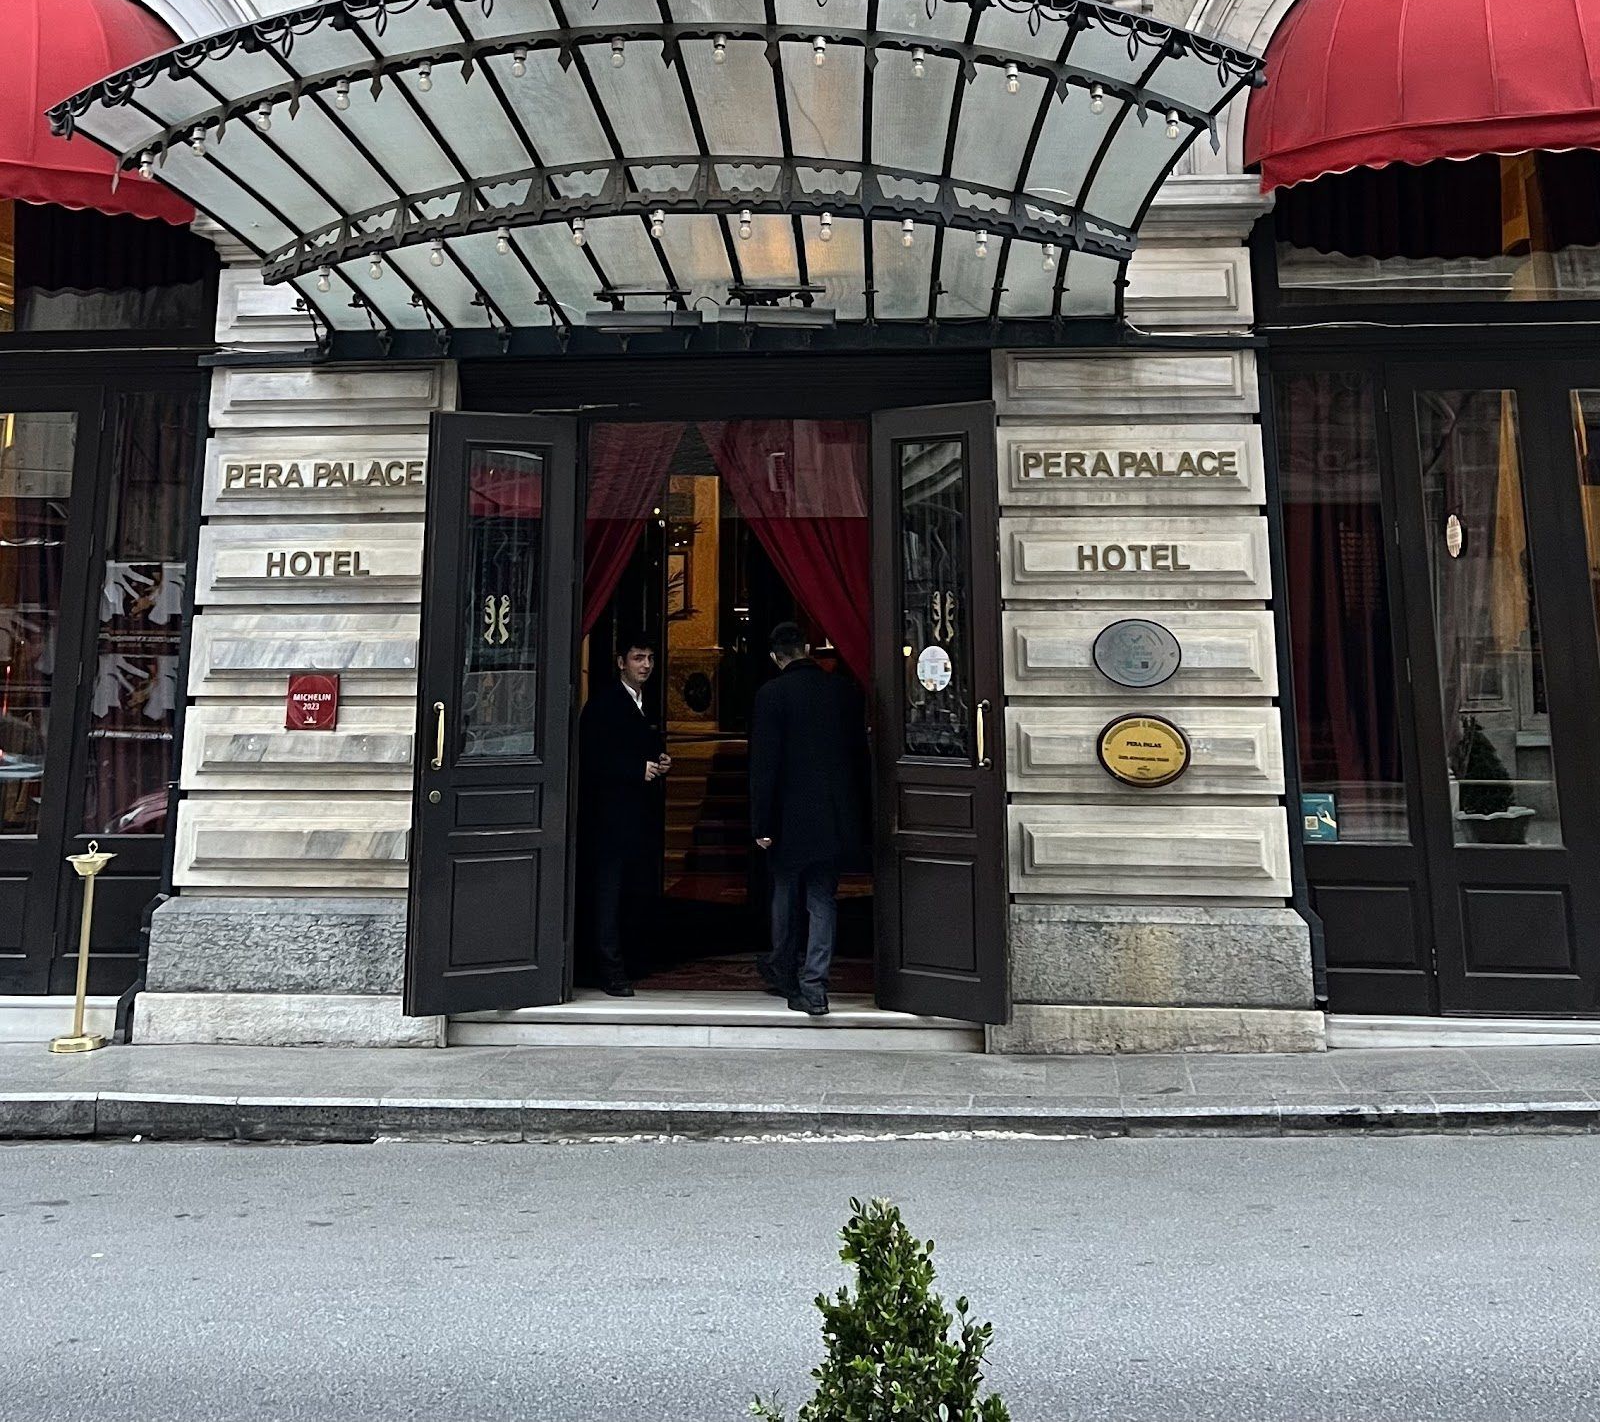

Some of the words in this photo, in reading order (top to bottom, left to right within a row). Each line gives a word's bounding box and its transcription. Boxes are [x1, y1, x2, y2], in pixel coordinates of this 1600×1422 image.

[225, 463, 305, 489] PERA
[313, 460, 424, 487] PALACE
[1022, 451, 1114, 477] PERA
[1118, 451, 1238, 477] PALACE
[266, 551, 370, 577] HOTEL
[1077, 544, 1191, 571] HOTEL
[292, 693, 332, 701] MICHELIN
[302, 702, 320, 711] 2023
